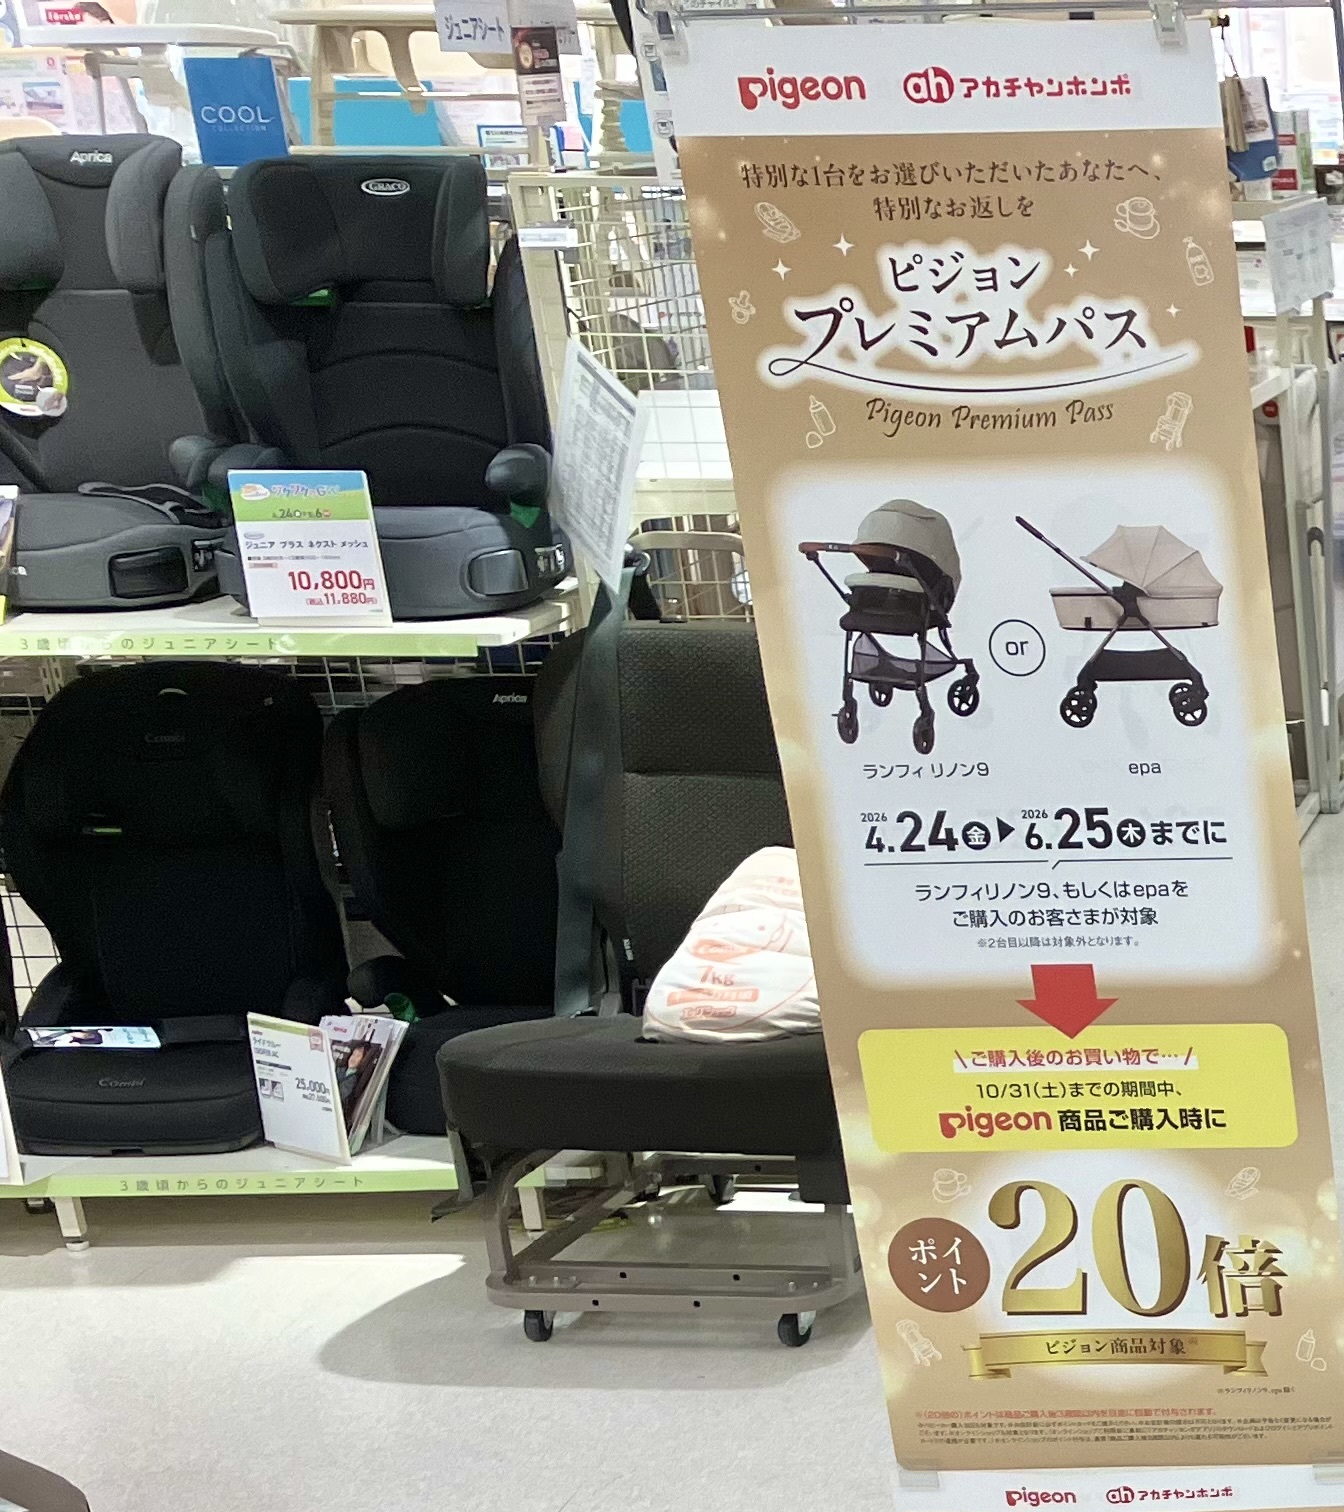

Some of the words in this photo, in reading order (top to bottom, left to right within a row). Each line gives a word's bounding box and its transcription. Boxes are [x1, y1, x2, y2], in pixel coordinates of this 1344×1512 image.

[445, 15, 504, 40] ジュニアシート
[738, 67, 866, 110] pigeon
[201, 106, 272, 124] COOL
[70, 150, 113, 164] Aprica
[741, 159, 1162, 188] 特別な1台をお選びいただいたあなたへ、
[873, 196, 1033, 220] 特別なお返しを
[888, 252, 1040, 294] ピジョン
[795, 298, 1148, 359] プレミアムパス
[866, 398, 941, 437] Pigeon
[952, 406, 1056, 430] Premium
[1066, 398, 1114, 424] Pass
[288, 571, 375, 590] 10,800円
[1005, 639, 1029, 657] or
[1128, 761, 1161, 776] epa
[861, 813, 887, 822] 2026
[1021, 809, 1048, 819] 2026
[914, 880, 1188, 901] ランフィリノン9、もしくはepaを
[952, 908, 1159, 928] ご購入のお客さまが対象
[939, 1106, 1052, 1138] pigeon
[1059, 1107, 1227, 1132] 商品ご購入時に
[988, 1178, 1288, 1318] 20倍
[1006, 1486, 1076, 1506] pigeon
